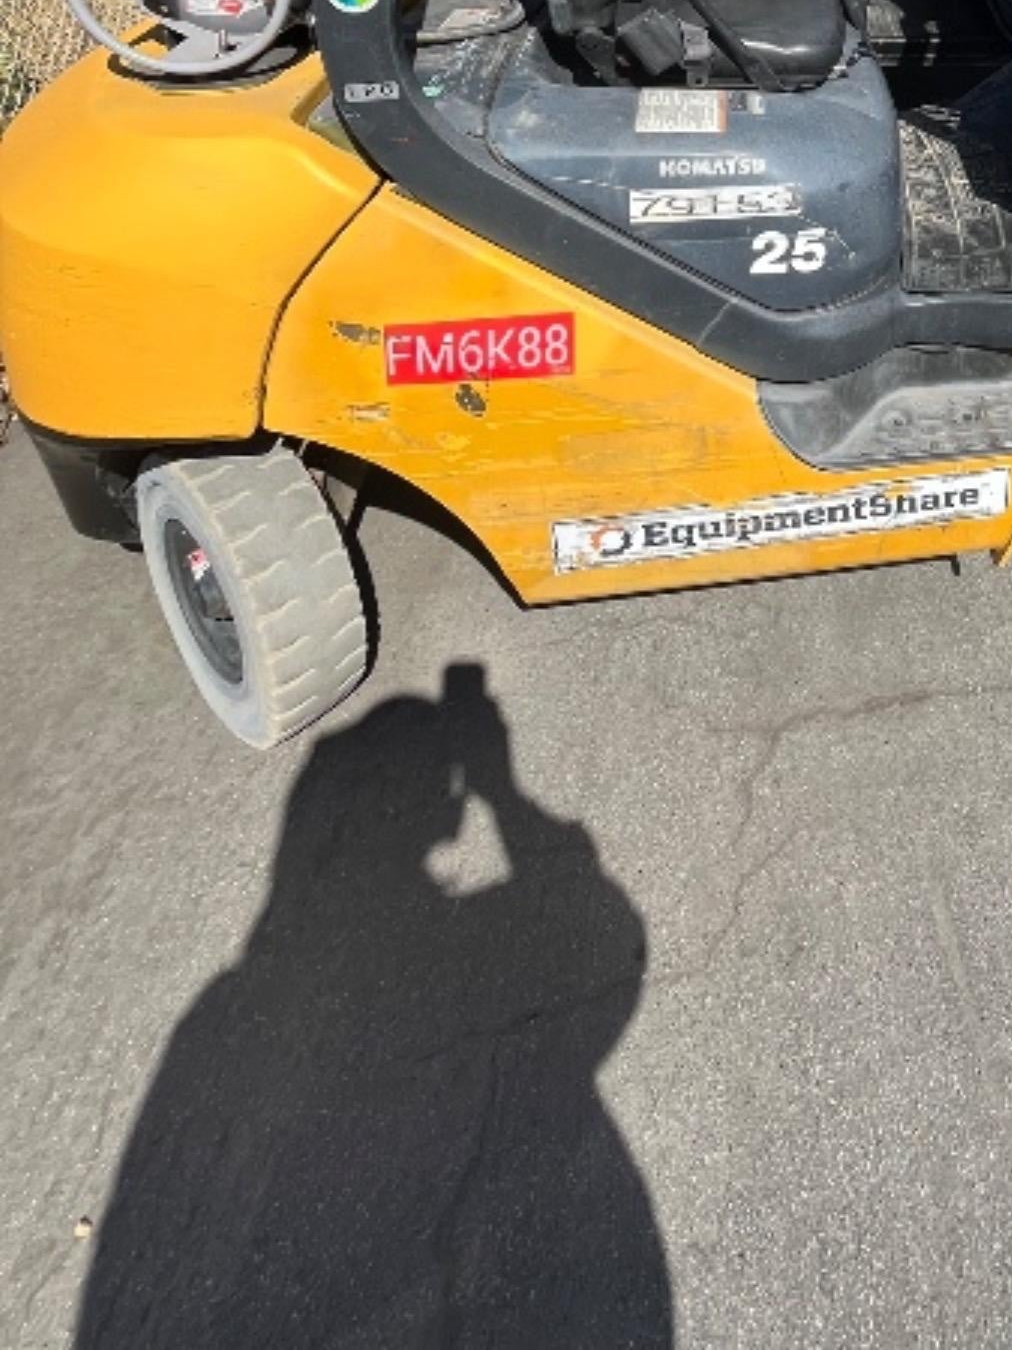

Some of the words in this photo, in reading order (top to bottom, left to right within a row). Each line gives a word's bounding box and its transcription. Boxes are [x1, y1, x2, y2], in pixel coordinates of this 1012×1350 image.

[658, 158, 768, 178] KOMATSU
[748, 227, 828, 275] 25
[386, 323, 569, 377] FM6K88
[641, 485, 980, 551] EquipmentShare
